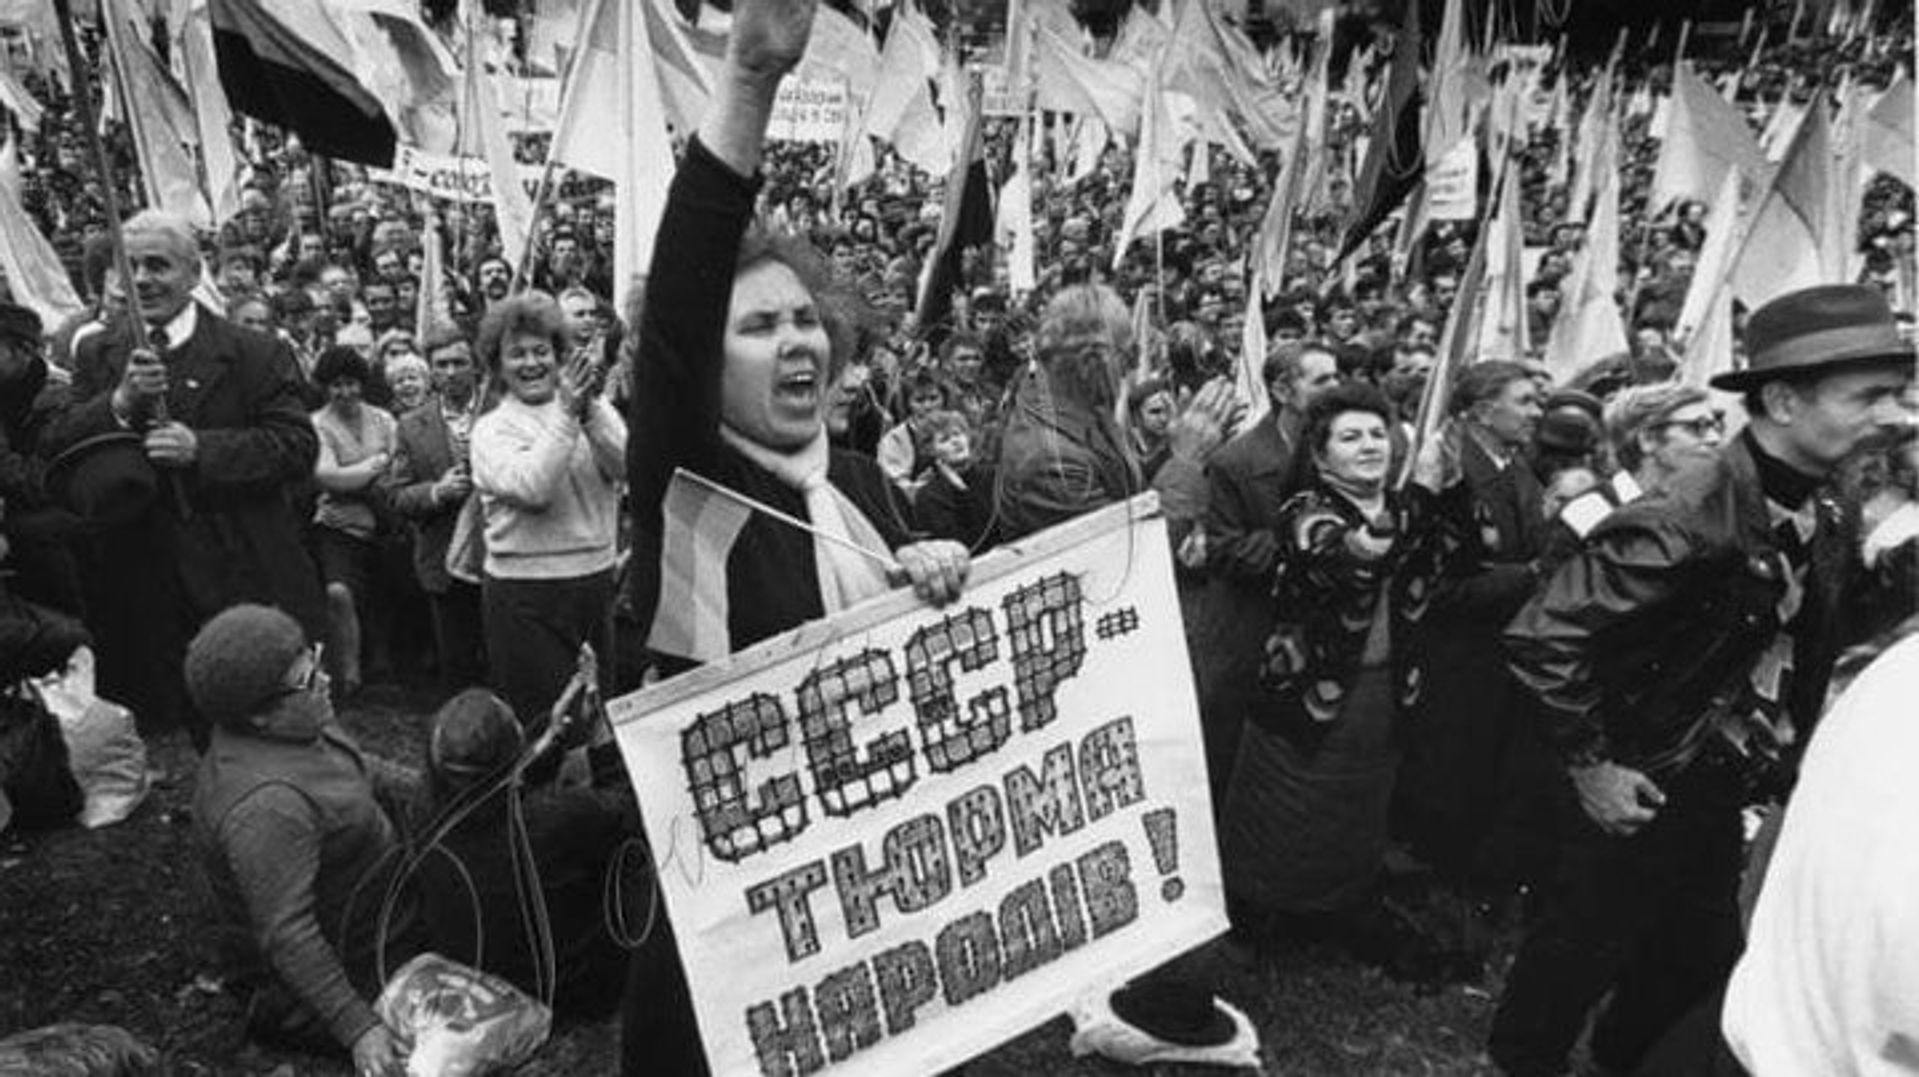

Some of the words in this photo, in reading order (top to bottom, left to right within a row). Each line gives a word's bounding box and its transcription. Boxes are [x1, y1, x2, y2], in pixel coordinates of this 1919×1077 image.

[680, 571, 1139, 864] СССР-
[744, 715, 1146, 964] ТЮРМА
[746, 807, 1185, 1077] НАРОДІВ!
